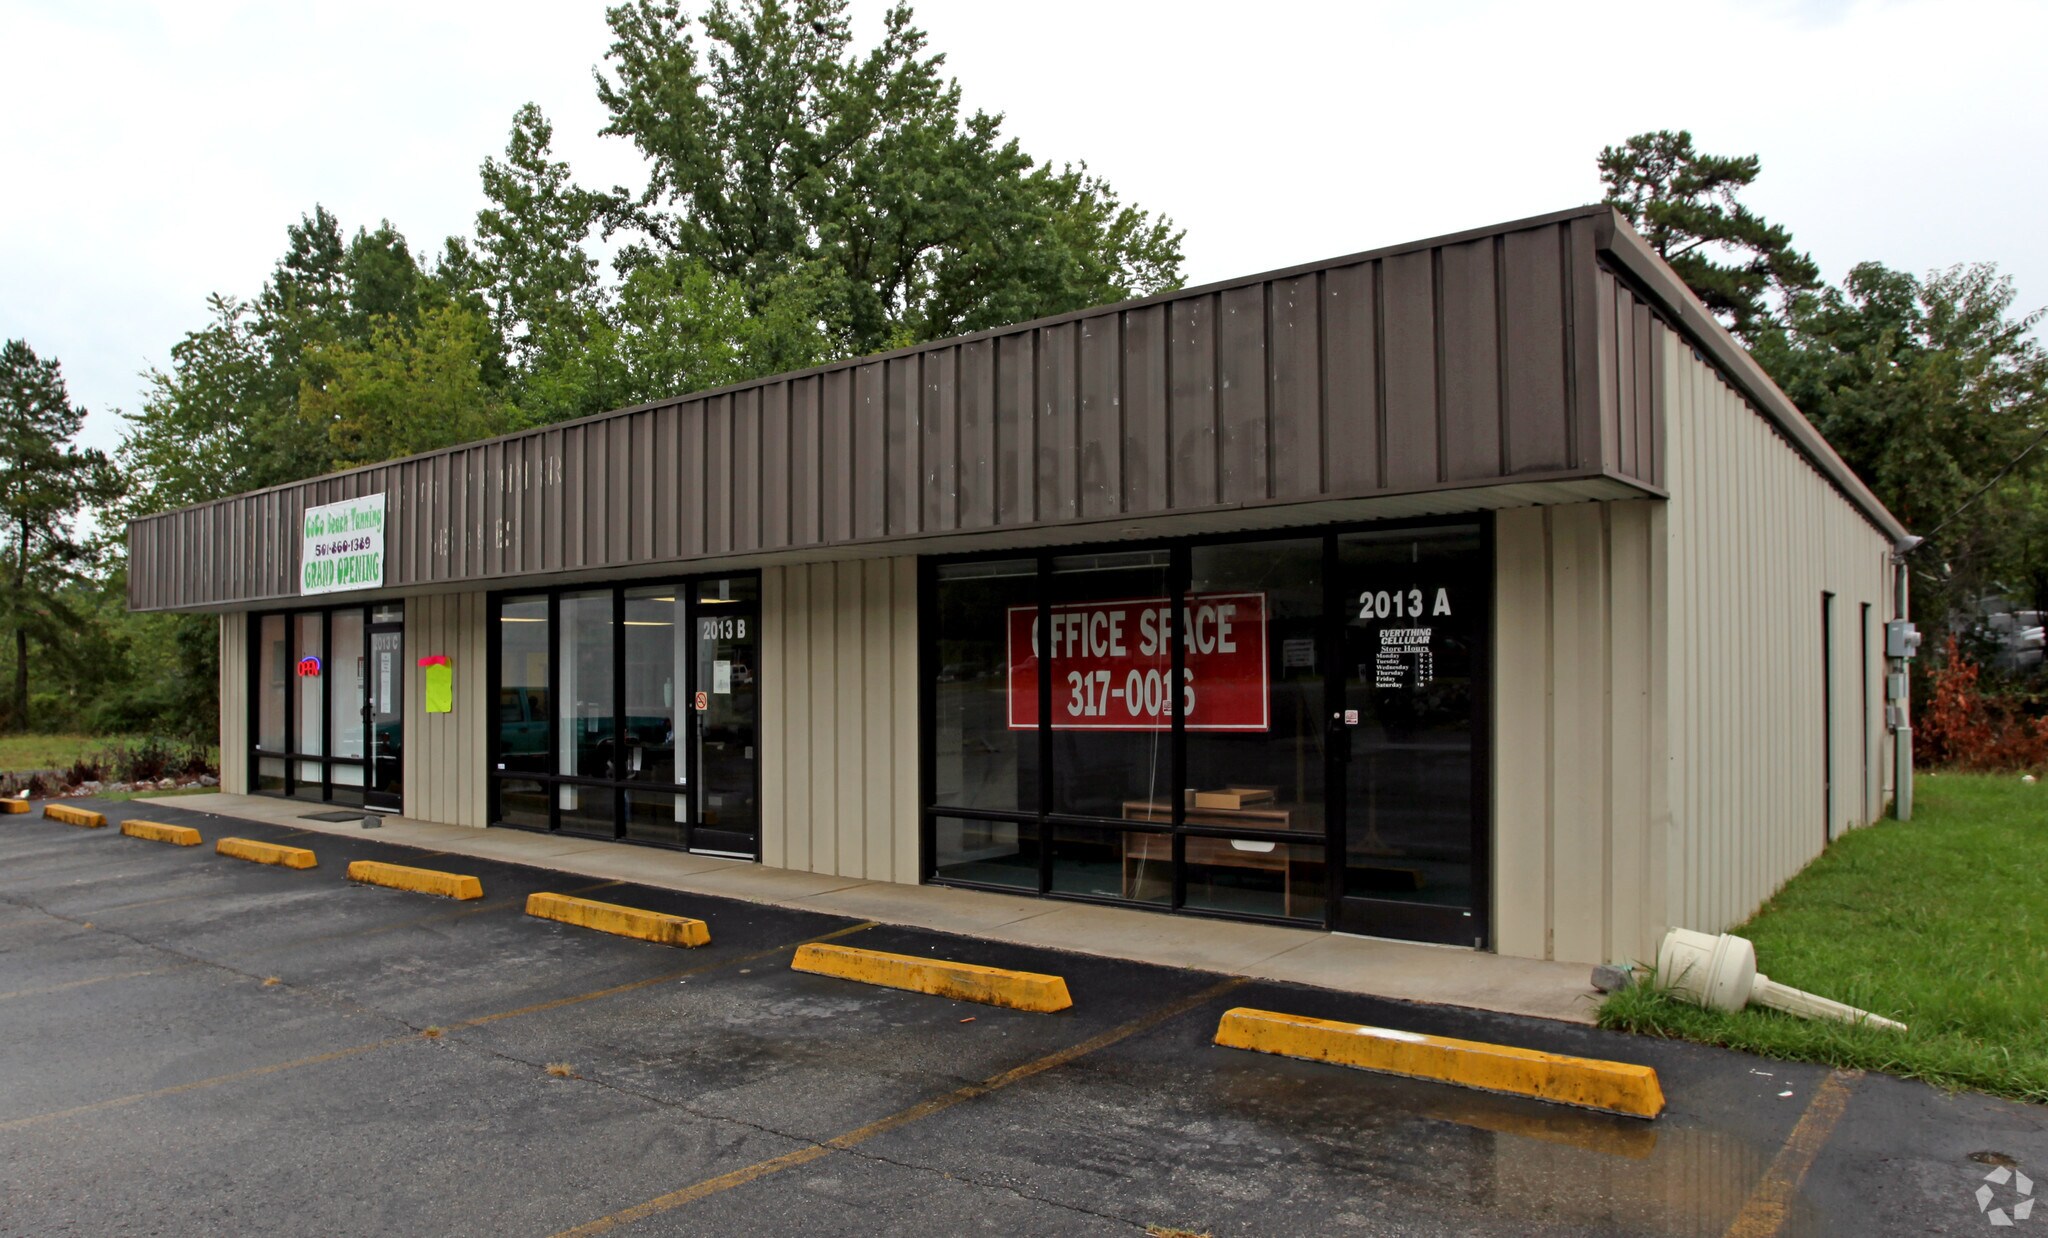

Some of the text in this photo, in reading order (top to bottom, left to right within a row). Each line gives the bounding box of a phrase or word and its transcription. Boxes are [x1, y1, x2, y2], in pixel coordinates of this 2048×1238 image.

[351, 506, 382, 532] Tanning
[305, 551, 380, 589] GRAND OPENING
[1359, 587, 1452, 619] 2013 A
[703, 619, 746, 640] 2013 B
[1380, 628, 1432, 638] EVERYTHING
[392, 635, 399, 650] C
[1381, 636, 1430, 644] CELLULAR
[1381, 645, 1429, 653] Store Hours
[297, 661, 320, 677] OPEN
